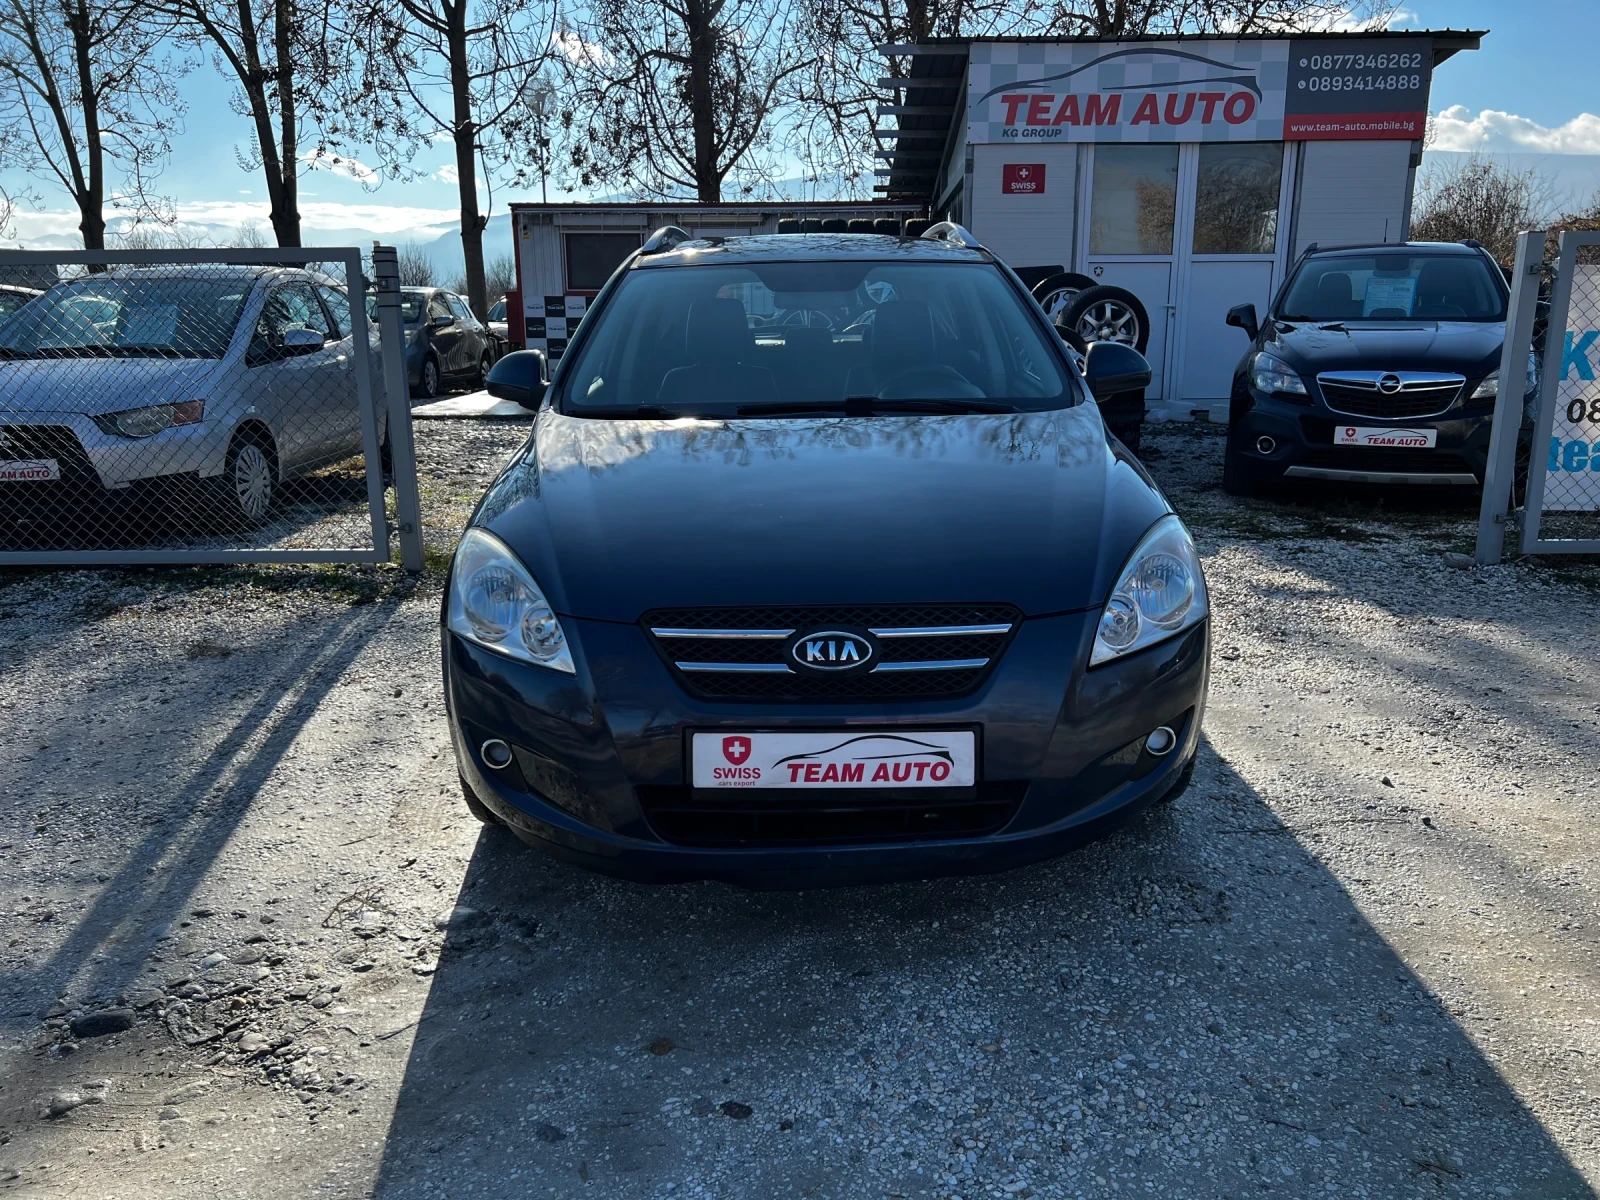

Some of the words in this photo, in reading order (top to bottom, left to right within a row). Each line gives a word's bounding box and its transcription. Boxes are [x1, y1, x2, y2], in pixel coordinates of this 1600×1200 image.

[1310, 53, 1421, 70] 0877346262
[1309, 75, 1420, 91] 0893414888
[1000, 94, 1122, 126] TEAM
[1130, 92, 1255, 125] AUTO
[1002, 128, 1019, 138] KG
[1022, 128, 1062, 138] GROUP
[1291, 121, 1414, 132] www.team-auto.mobile.bg
[1011, 182, 1036, 190] SWISS
[1560, 331, 1600, 381] K
[1367, 437, 1396, 445] TEAM
[1397, 438, 1427, 446] AUTO
[20, 470, 50, 479] AUTO
[806, 641, 860, 661] KIA
[713, 767, 761, 780] SWISS
[787, 763, 865, 783] TEAM
[871, 761, 951, 782] AUTO
[733, 780, 756, 788] export
